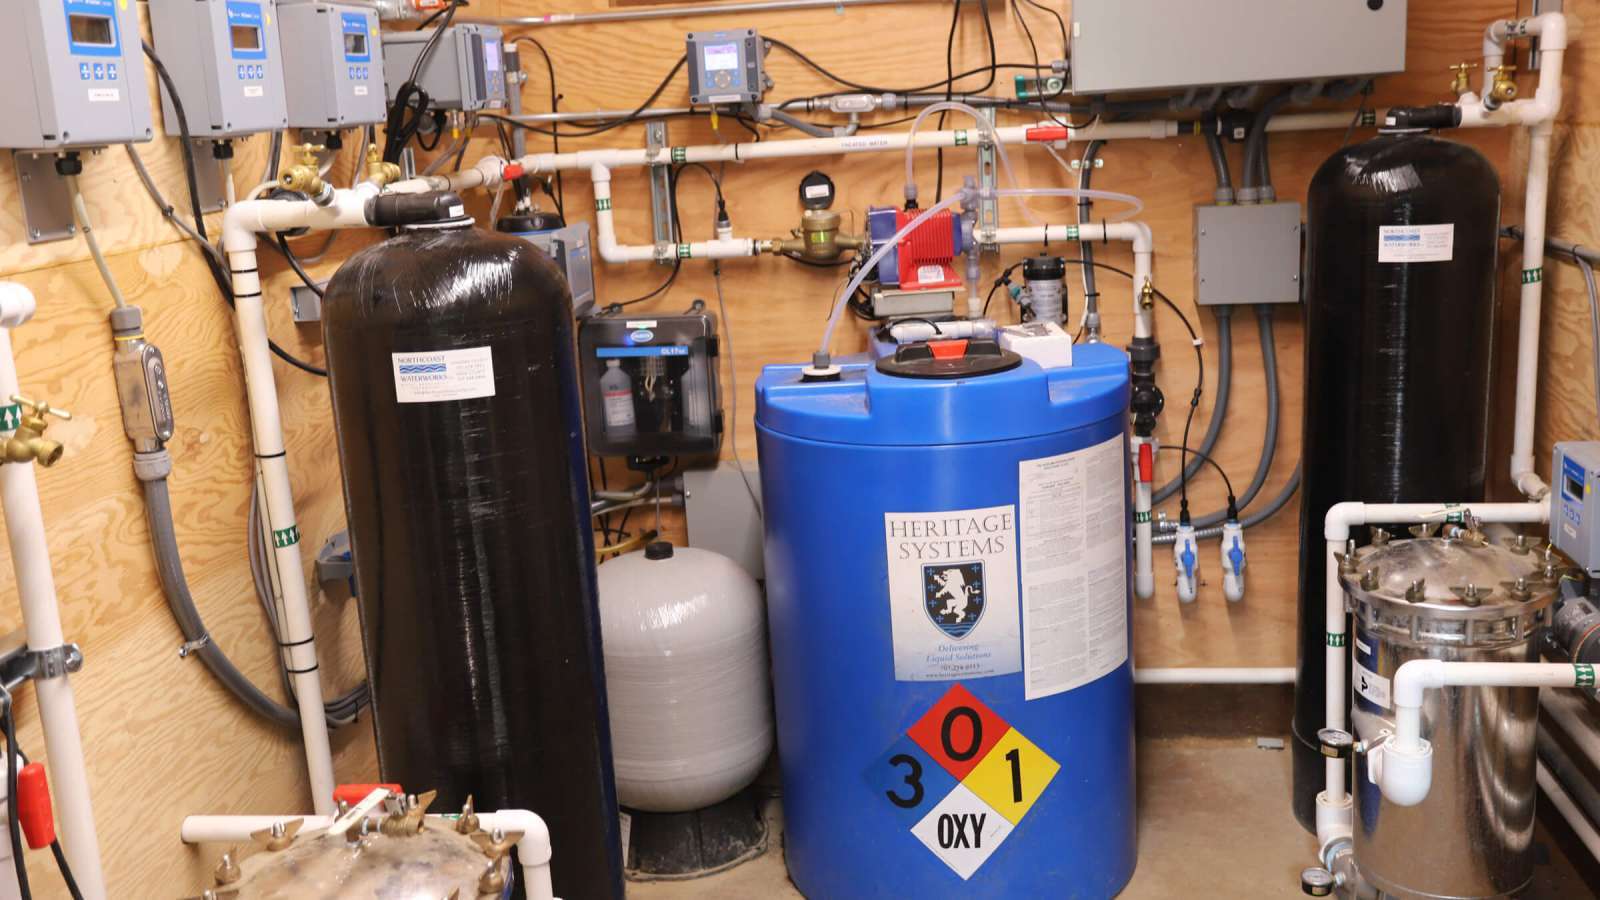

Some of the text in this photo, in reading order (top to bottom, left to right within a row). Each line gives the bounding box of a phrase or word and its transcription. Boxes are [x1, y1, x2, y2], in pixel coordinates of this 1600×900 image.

[397, 355, 445, 364] NORTHCOAST
[400, 374, 448, 383] WATERWORKS
[890, 513, 1012, 538] HERITAGE
[899, 536, 1006, 560] SYSTEMS
[926, 654, 953, 664] Liquid
[940, 705, 983, 762] 0
[885, 753, 925, 809] 3
[1005, 748, 1023, 804] 1
[937, 813, 987, 849] OXY
